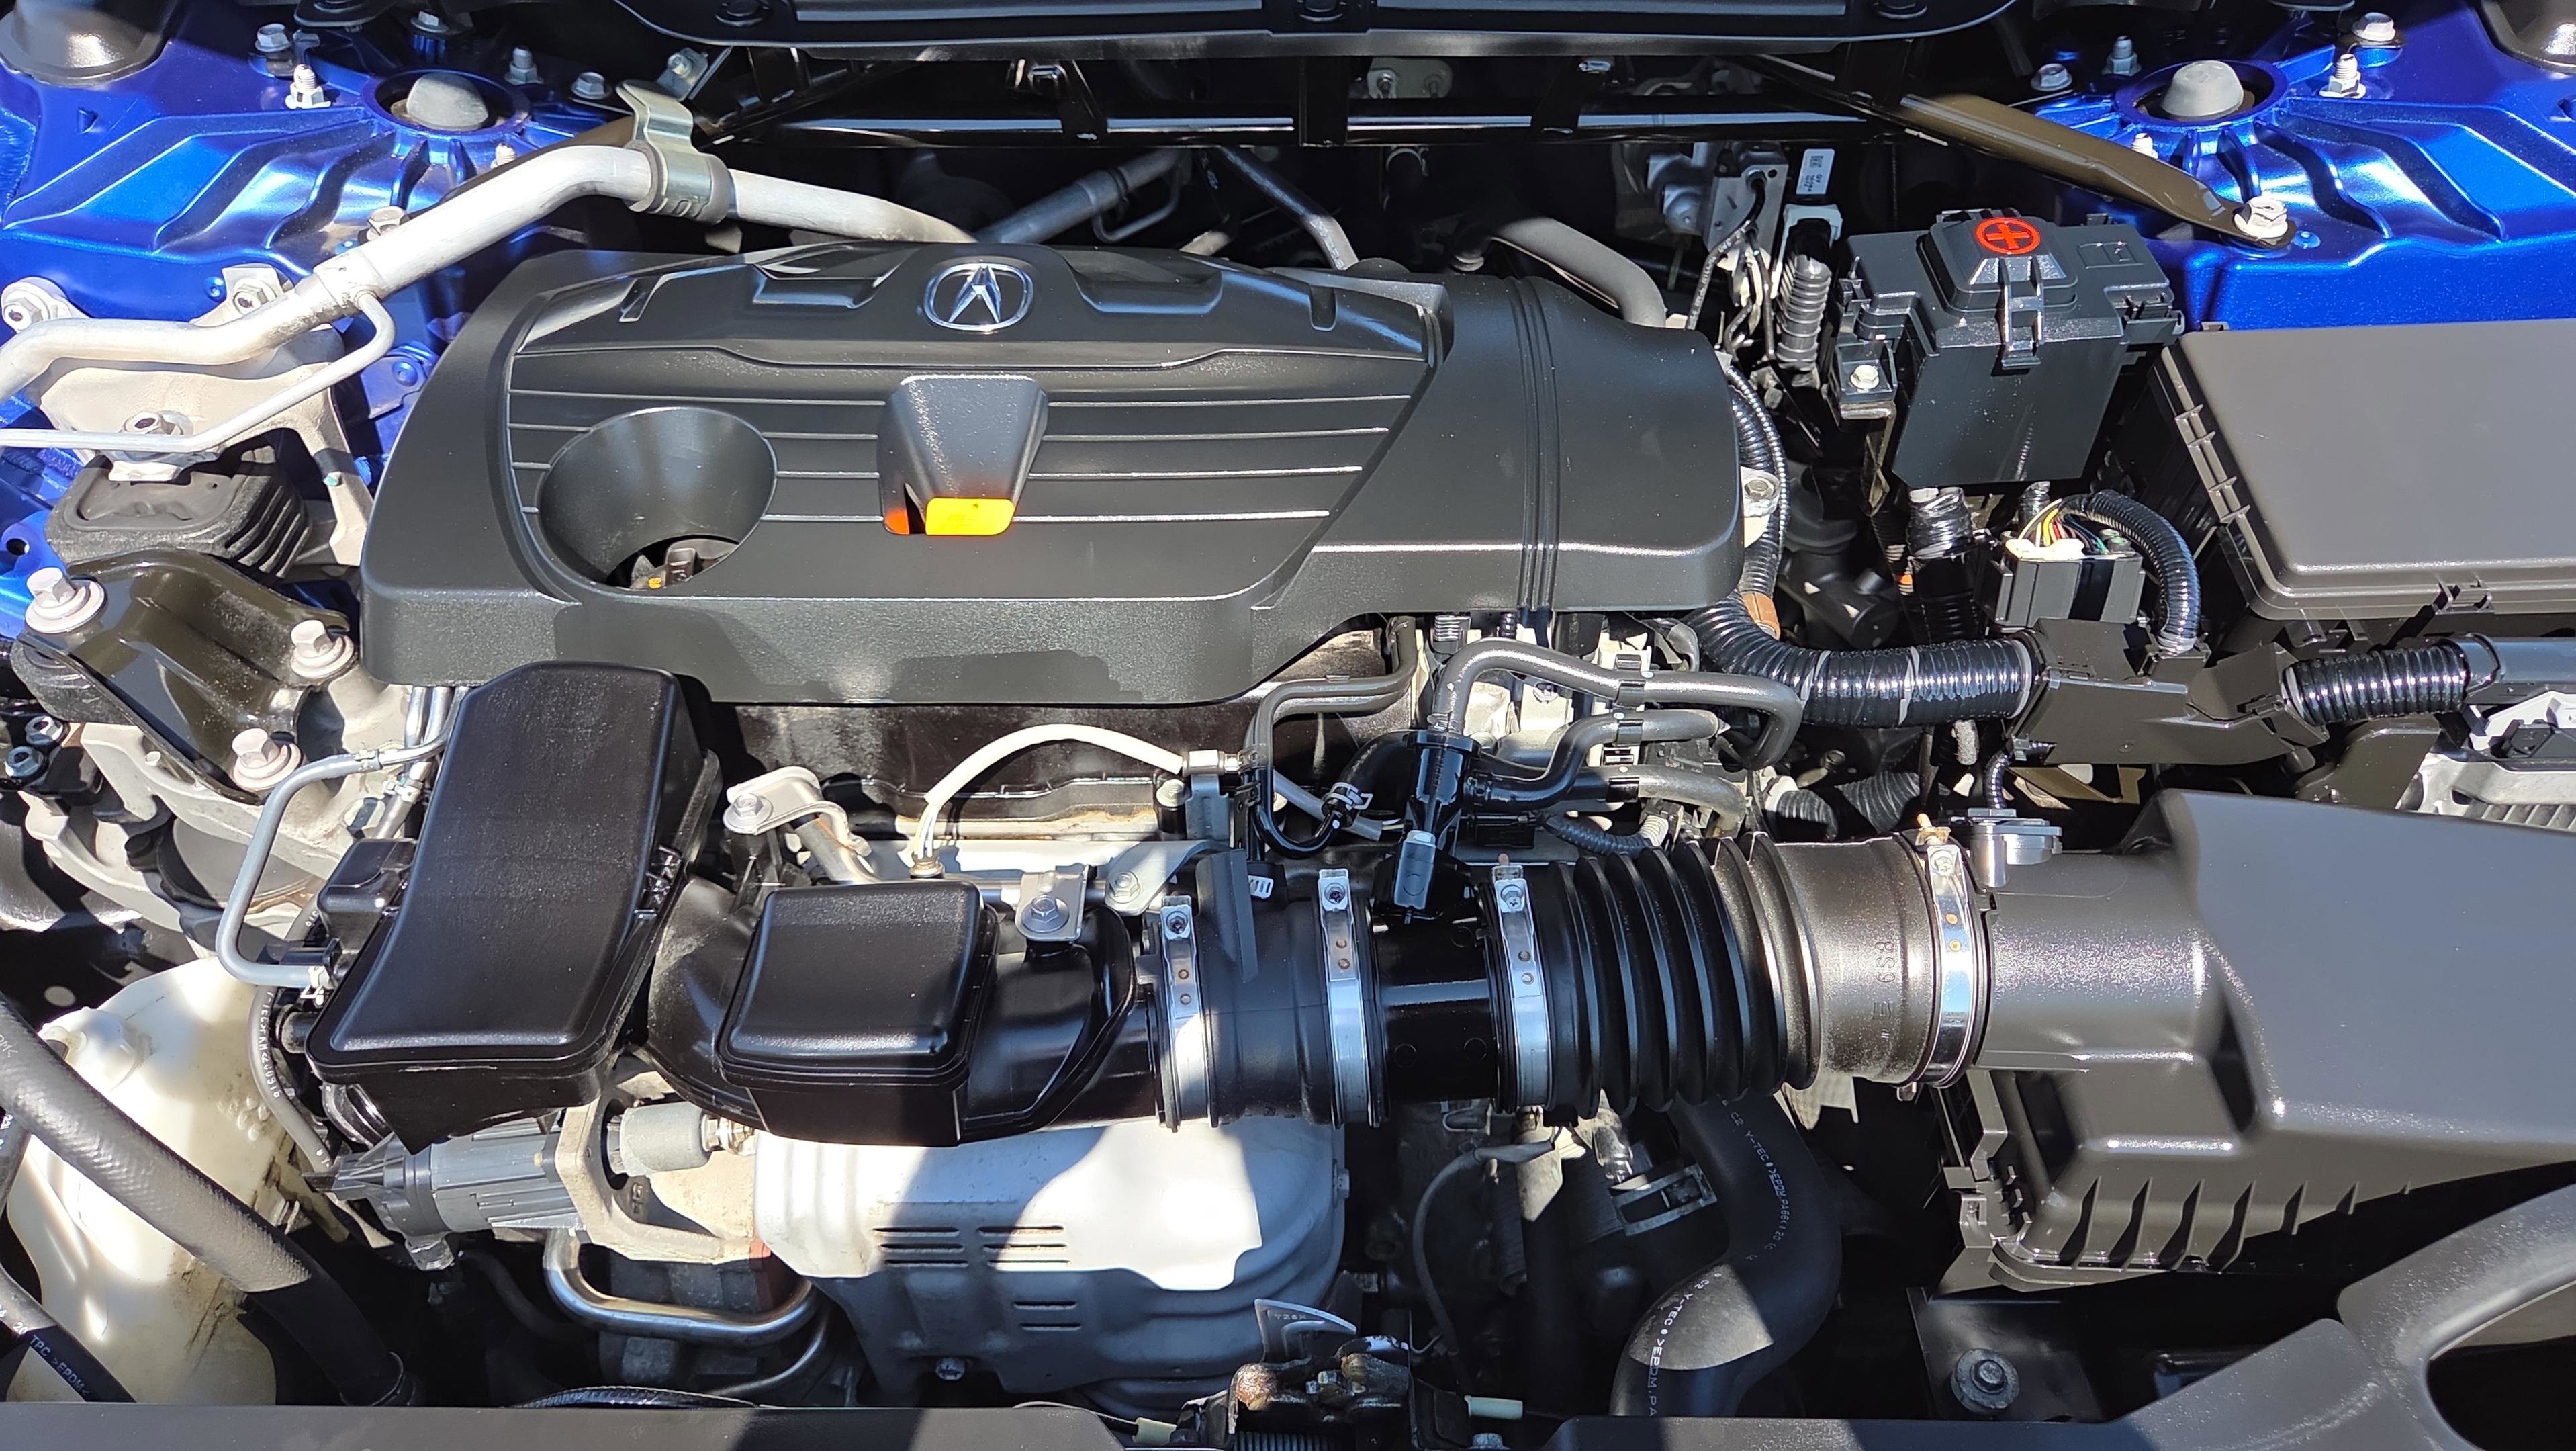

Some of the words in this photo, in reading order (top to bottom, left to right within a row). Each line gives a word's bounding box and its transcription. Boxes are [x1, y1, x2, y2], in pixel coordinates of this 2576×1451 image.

[1745, 1130, 1770, 1161] Y-TEC
[1663, 1293, 1694, 1327] Y-TEC
[30, 1334, 51, 1357] TPC
